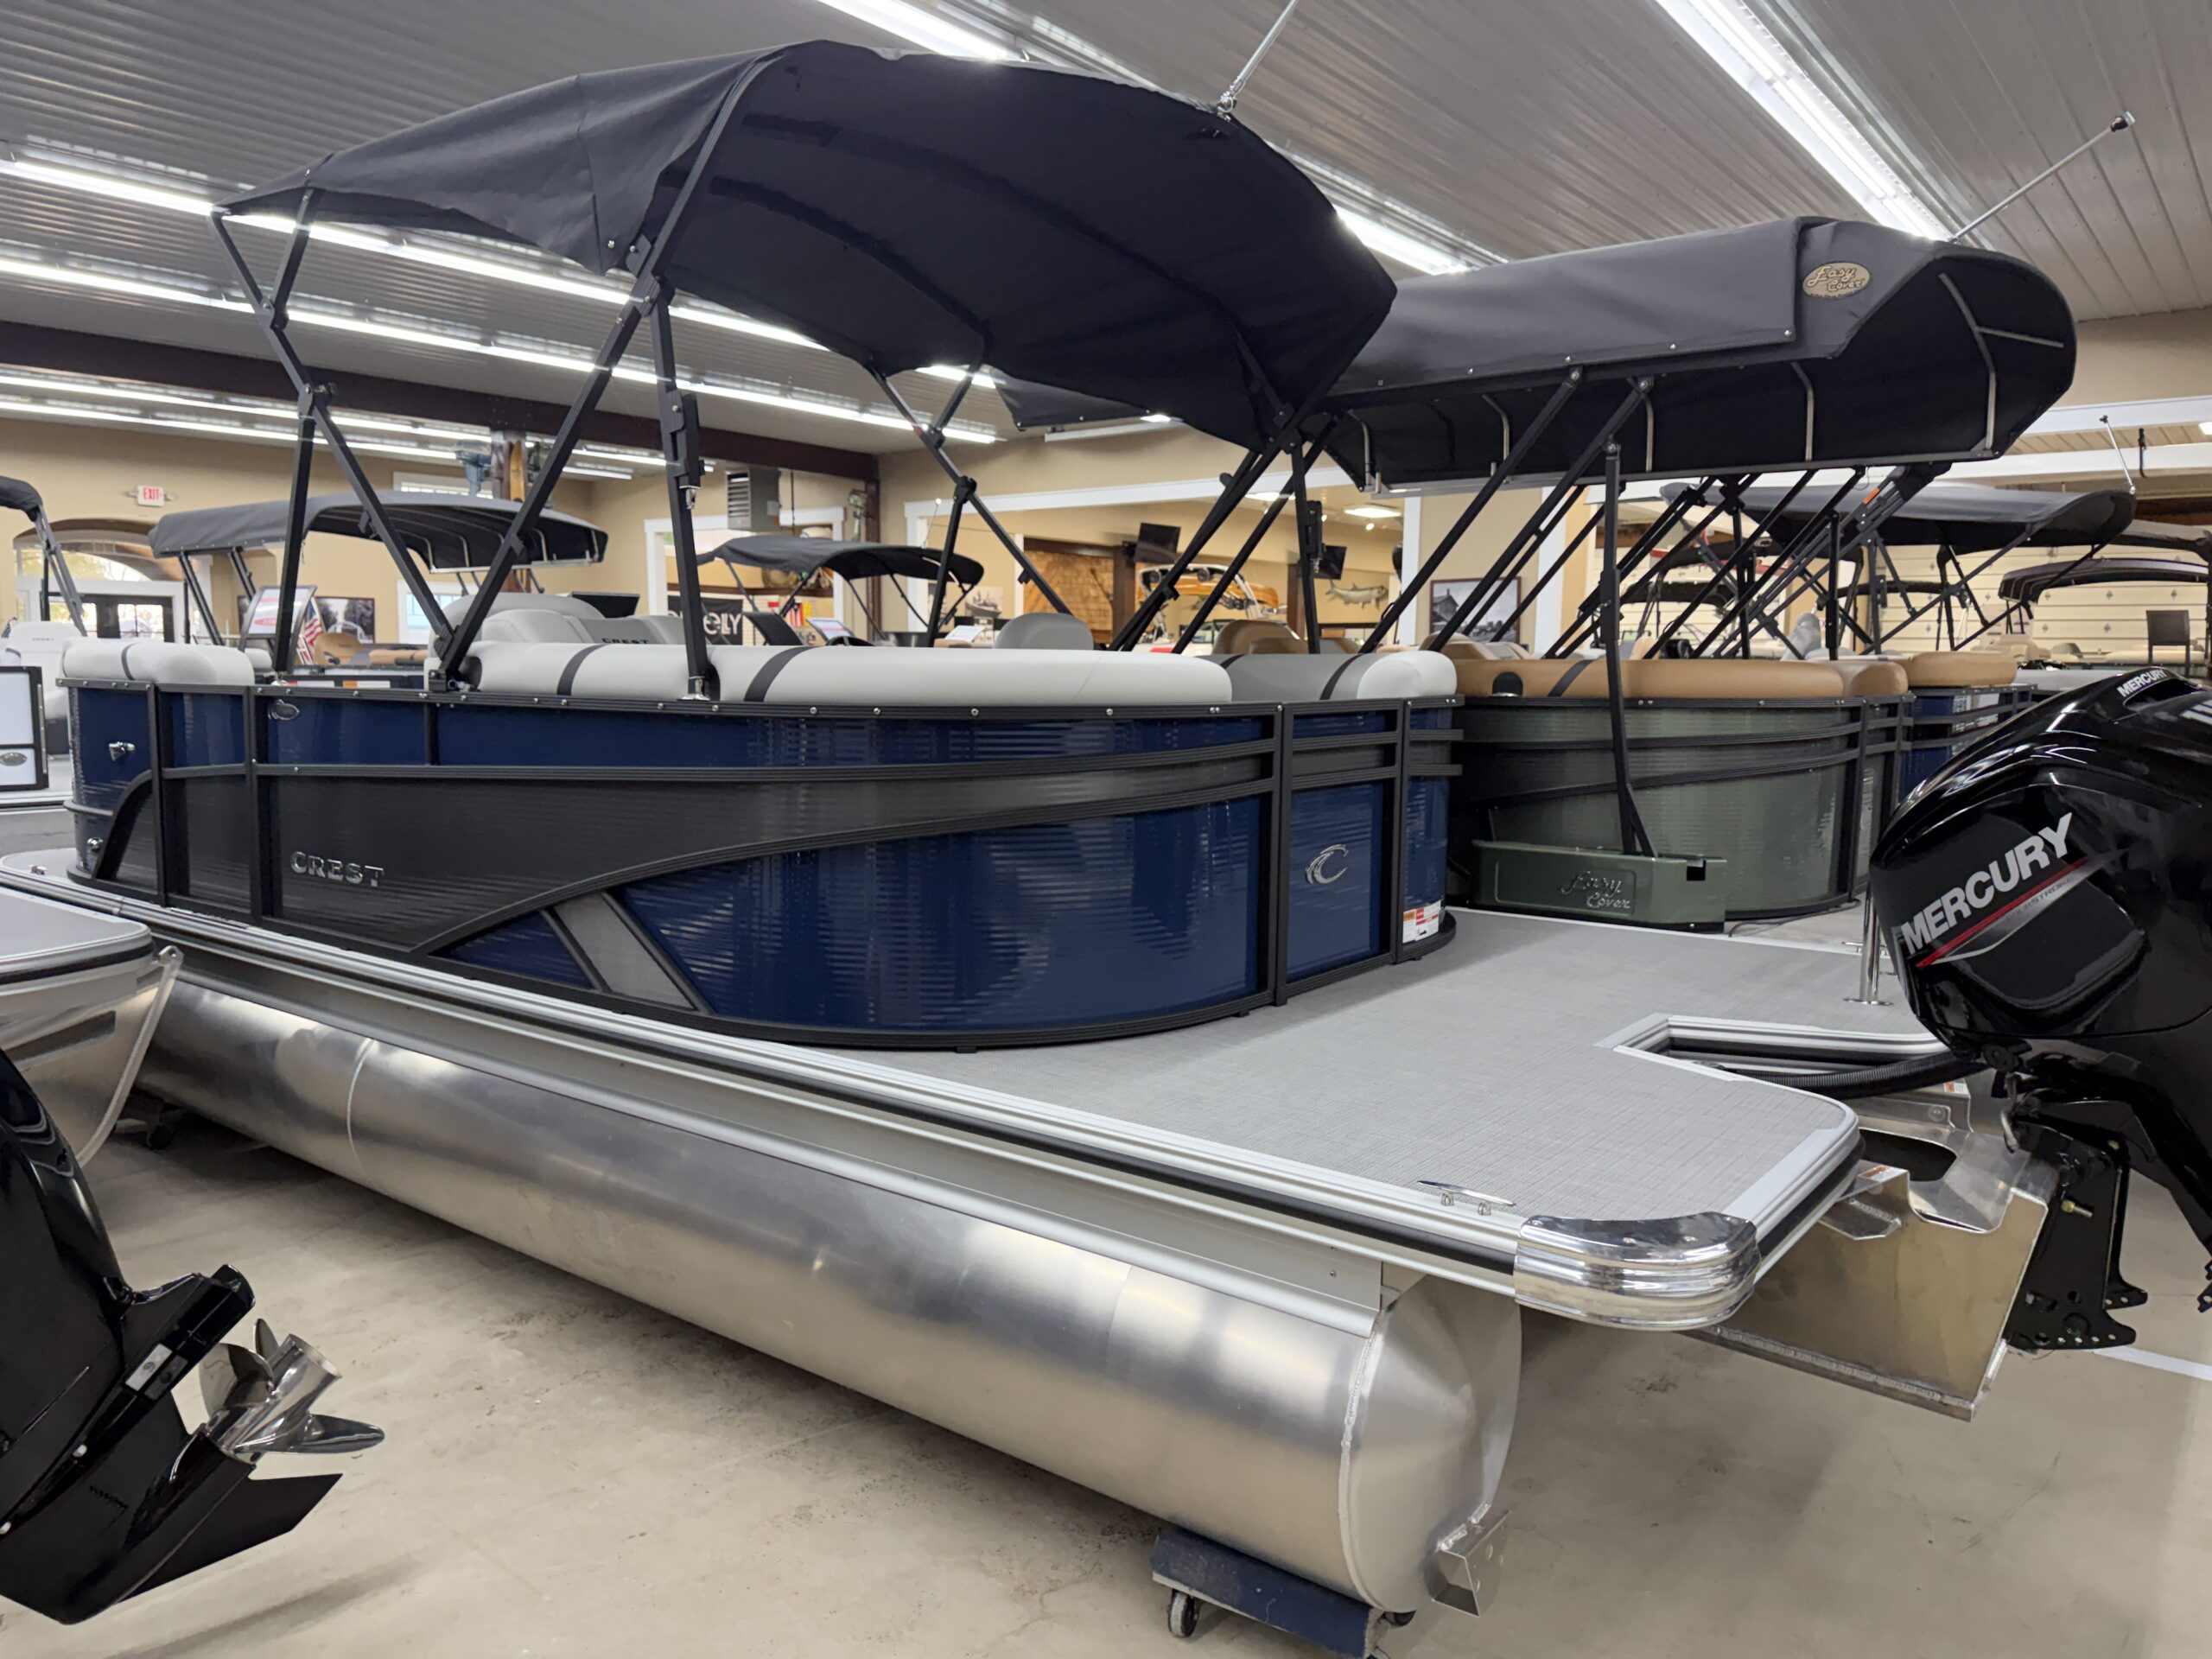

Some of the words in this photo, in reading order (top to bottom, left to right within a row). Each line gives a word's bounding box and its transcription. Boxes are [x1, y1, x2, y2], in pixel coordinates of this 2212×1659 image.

[1806, 266, 1857, 288] Easy
[1827, 279, 1861, 292] Cover
[143, 487, 159, 500] EXIT
[2116, 669, 2167, 697] MERCURY
[290, 851, 385, 888] CREST
[1901, 811, 2073, 956] MERCURY
[1586, 892, 1630, 909] Cover
